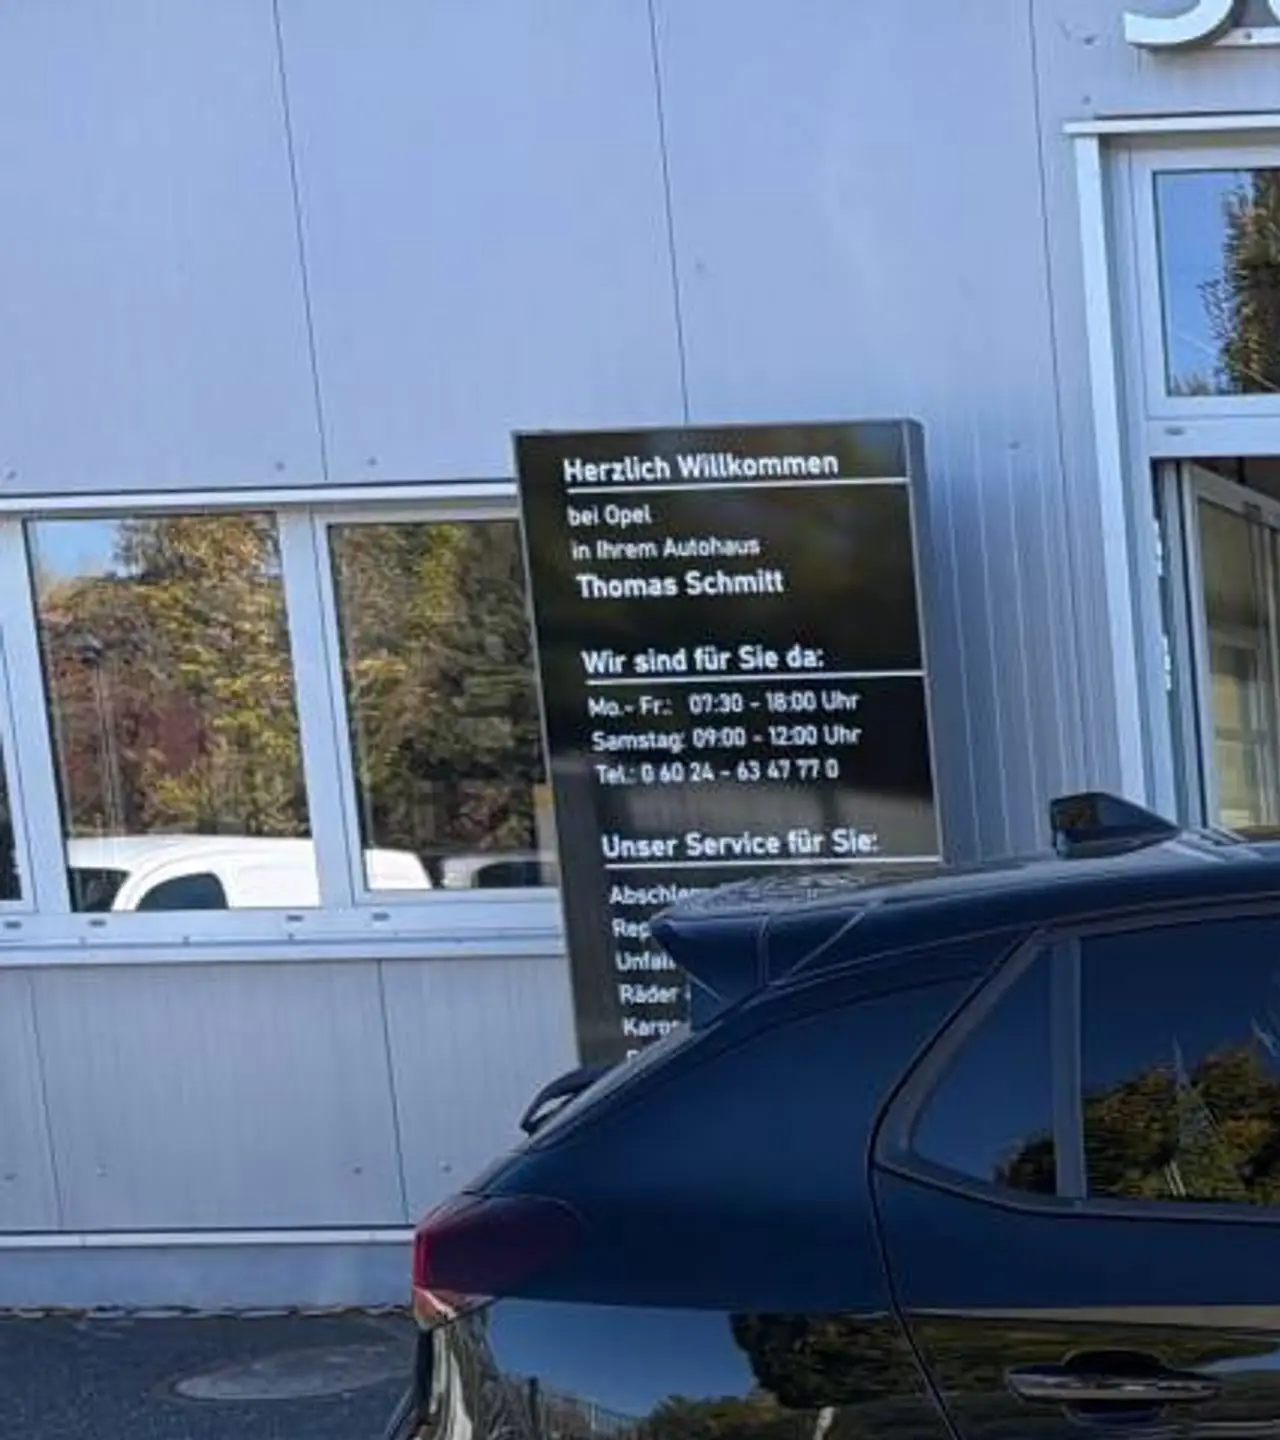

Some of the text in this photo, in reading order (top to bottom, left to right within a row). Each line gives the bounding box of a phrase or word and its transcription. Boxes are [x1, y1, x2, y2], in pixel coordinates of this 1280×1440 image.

[563, 452, 839, 482] Herzlich Willkommen
[567, 504, 652, 529] bei Opel
[572, 536, 761, 560] in Ihrem Autohaus
[575, 568, 784, 598] Thomas Schmitt
[581, 645, 824, 674] Wir sind für Sie da:
[688, 692, 744, 716] 07:30
[765, 690, 817, 712] 18:00
[821, 689, 861, 711] Uhr
[591, 730, 686, 754] Samstag:
[693, 726, 746, 749] 09:00
[768, 724, 818, 746] 12:00
[823, 724, 862, 746] Uhr
[594, 764, 638, 785] Tel.:
[641, 761, 655, 783] 0
[659, 761, 685, 783] 60
[689, 761, 715, 781] 24
[737, 759, 761, 781] 63
[795, 758, 820, 780] 77
[825, 757, 839, 779] 0
[601, 828, 878, 859] Unser Service für Sie:
[620, 984, 678, 1004] Räder
